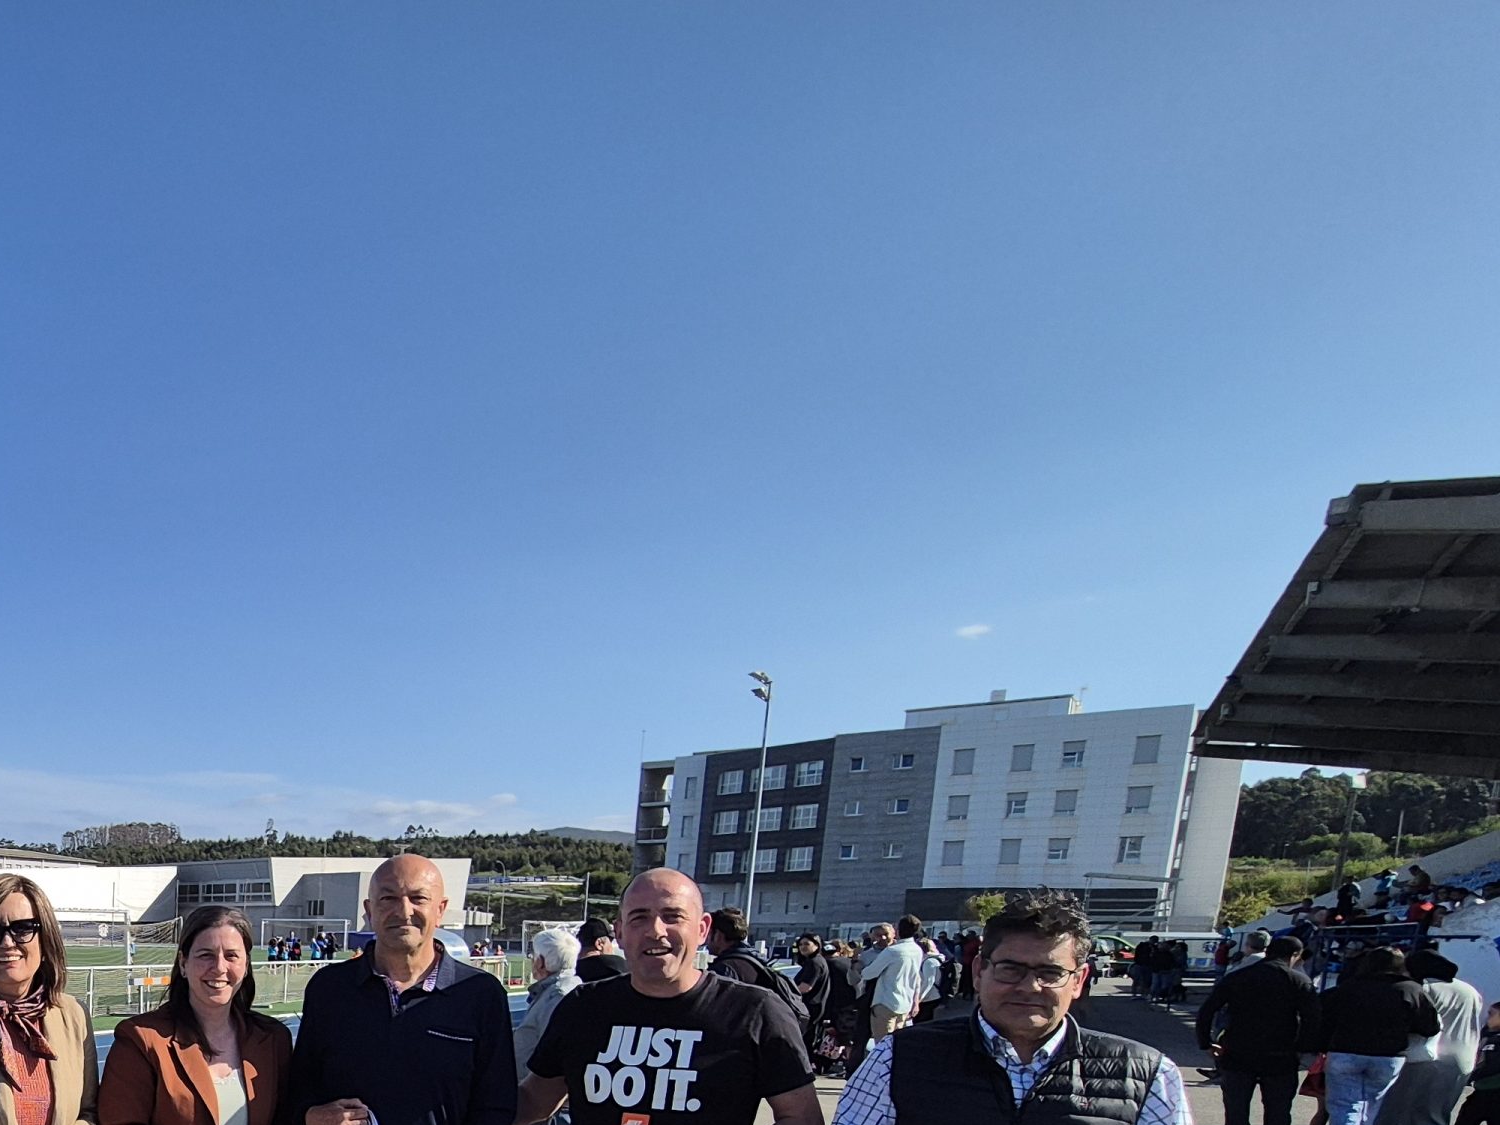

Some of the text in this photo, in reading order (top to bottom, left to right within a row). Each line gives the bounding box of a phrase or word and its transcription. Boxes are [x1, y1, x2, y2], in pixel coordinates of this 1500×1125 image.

[596, 1025, 703, 1069] JUST
[583, 1063, 701, 1112] DO IT.
